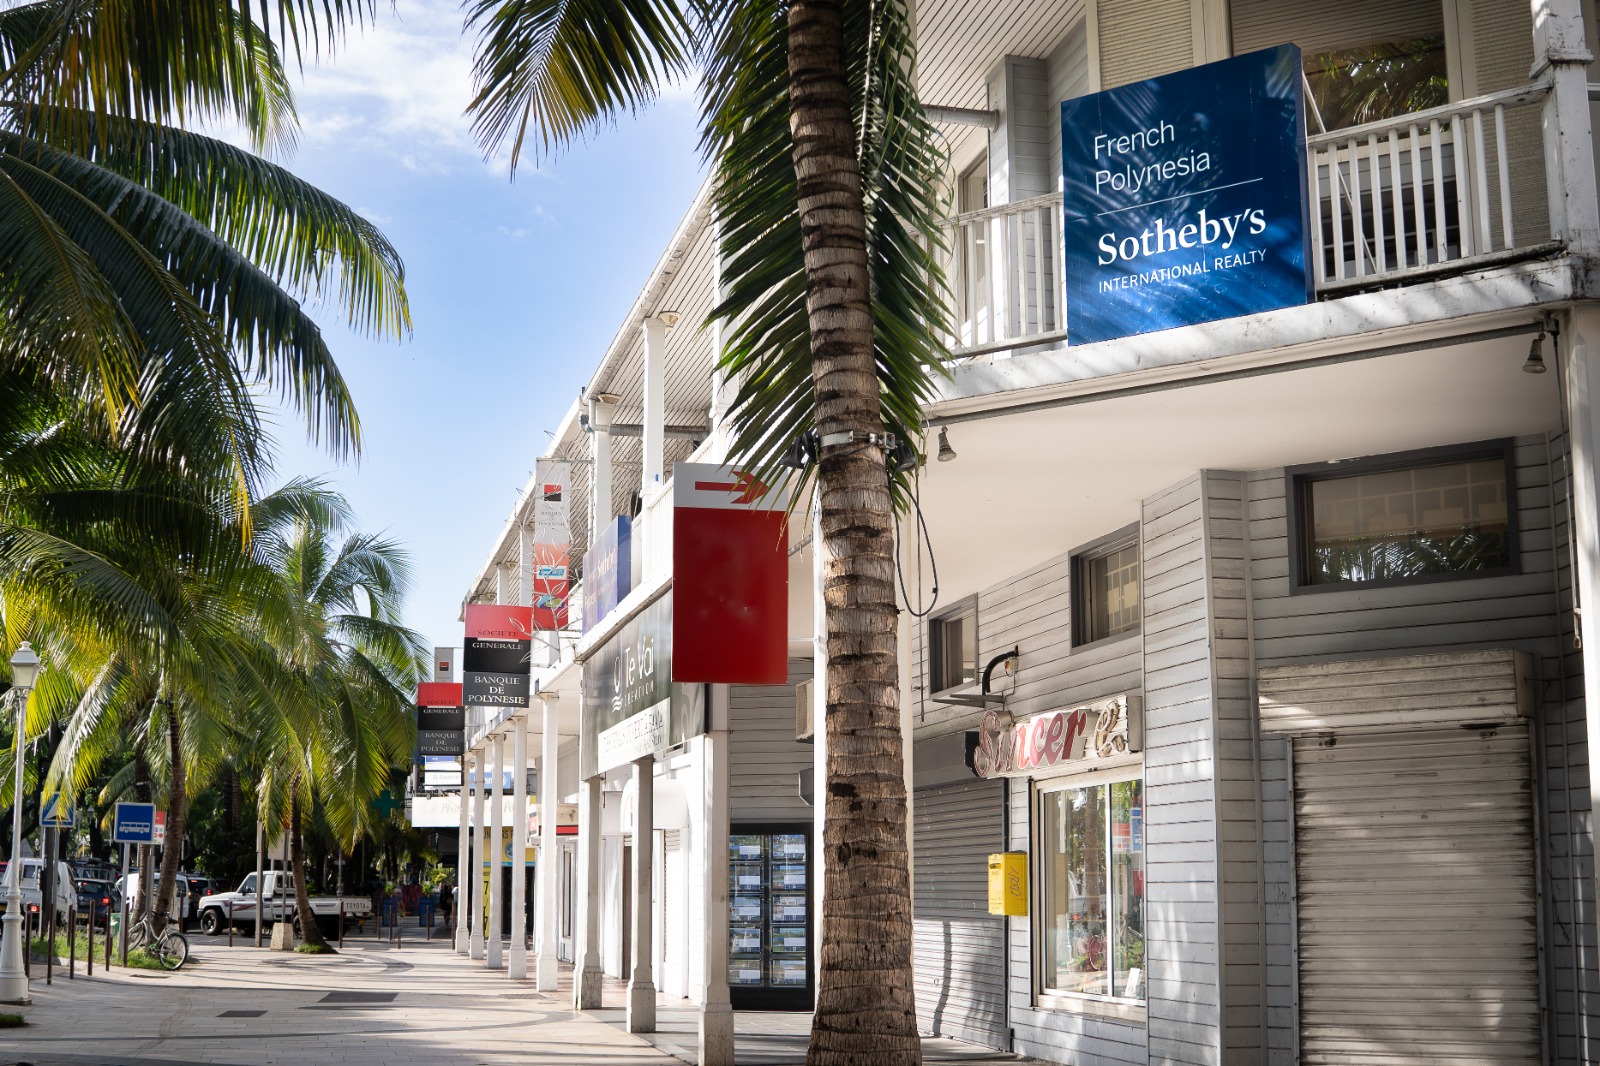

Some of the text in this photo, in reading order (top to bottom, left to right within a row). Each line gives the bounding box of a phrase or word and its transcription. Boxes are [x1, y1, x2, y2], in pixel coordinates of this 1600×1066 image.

[1094, 120, 1175, 159] French
[1095, 150, 1211, 195] Polynesia
[1098, 208, 1266, 266] Sotheby's
[1099, 249, 1267, 293] INTERNATIONAL REALTY
[472, 642, 523, 650] GENERALE
[625, 635, 654, 688] Te Vai
[468, 695, 525, 705] POLYNESIE
[474, 676, 520, 686] BANQUE
[489, 686, 505, 694] DE
